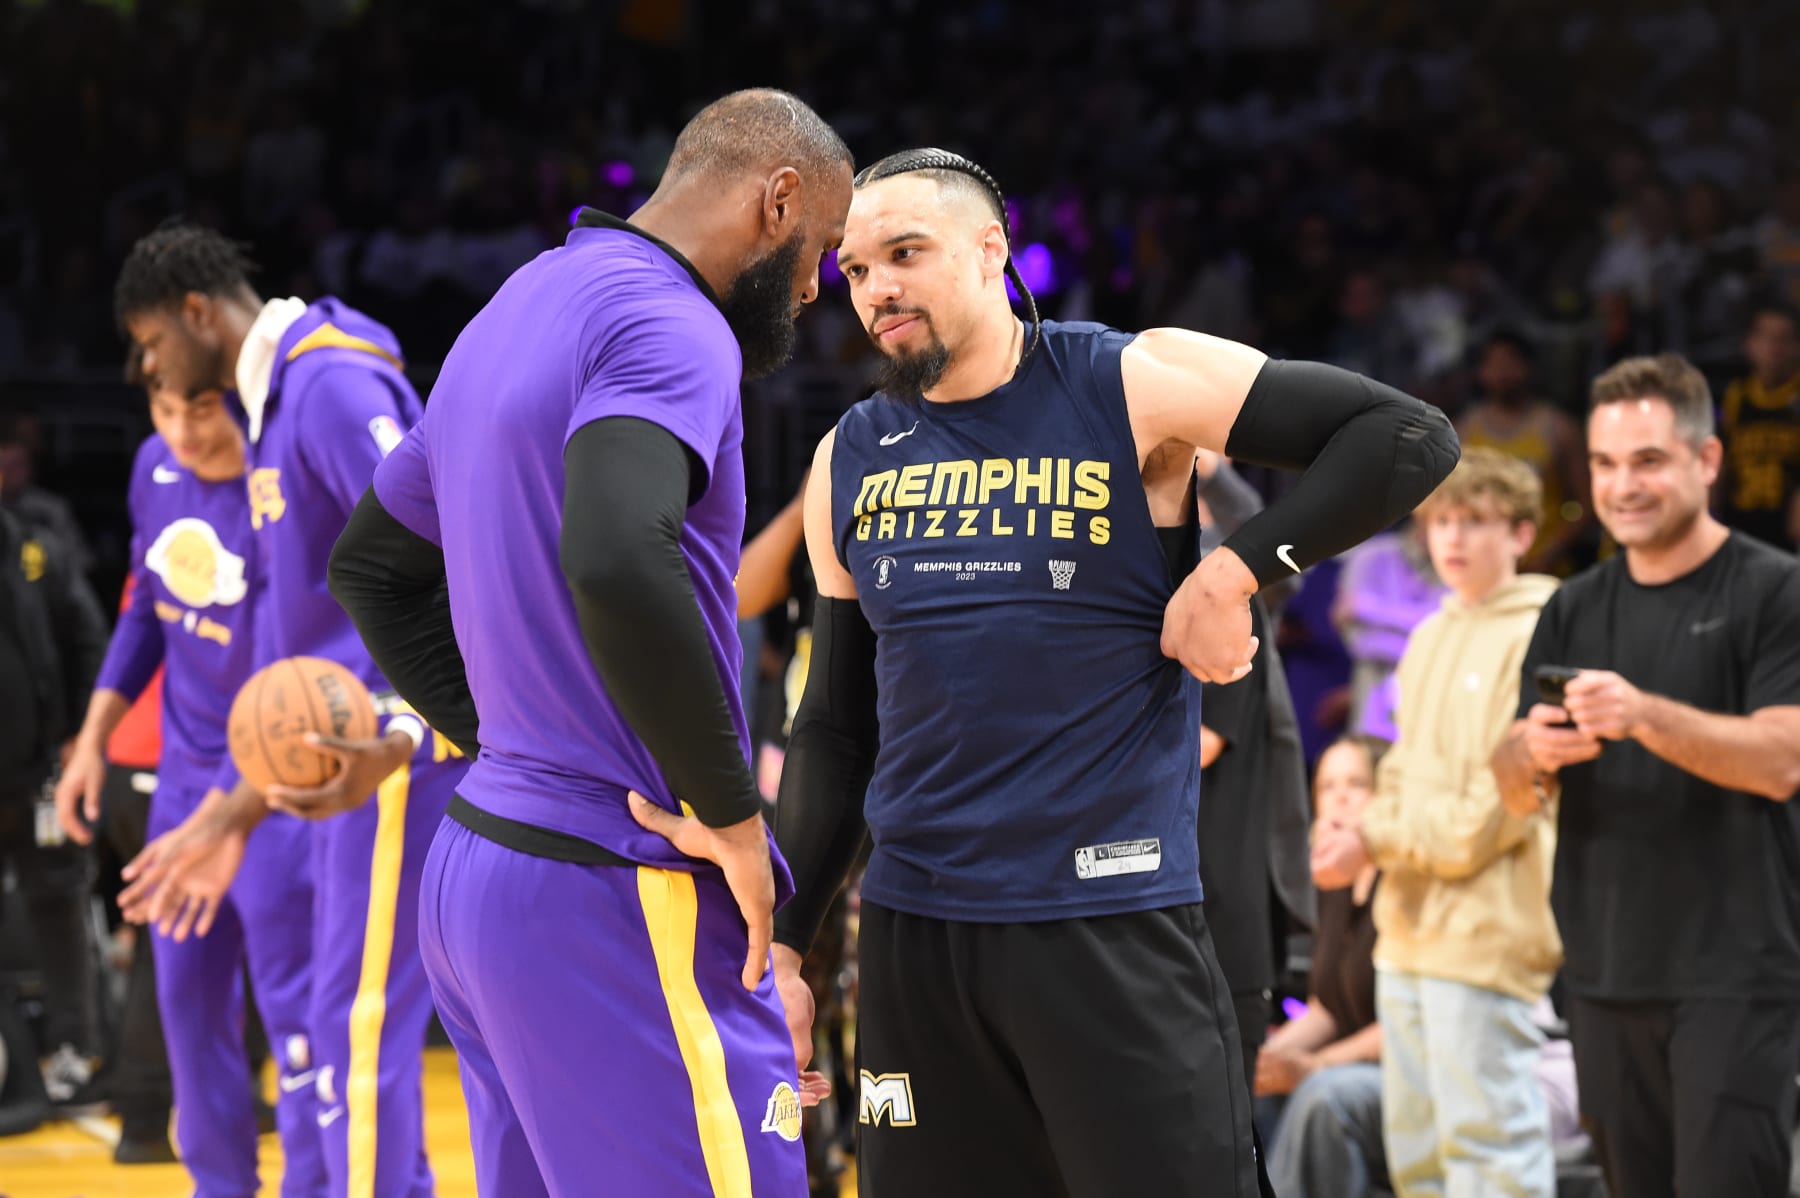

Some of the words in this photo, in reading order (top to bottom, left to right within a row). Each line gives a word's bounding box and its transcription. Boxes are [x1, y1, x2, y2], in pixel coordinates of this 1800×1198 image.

[853, 457, 1110, 517] MEMPHIS
[856, 508, 1111, 545] GRIZZLIES
[914, 562, 962, 572] MEMPHIS
[965, 561, 1022, 572] GRIZZLIES
[955, 572, 976, 581] 2023
[1098, 849, 1105, 858] L
[761, 1098, 802, 1133] LAKER
[859, 1068, 917, 1128] M
